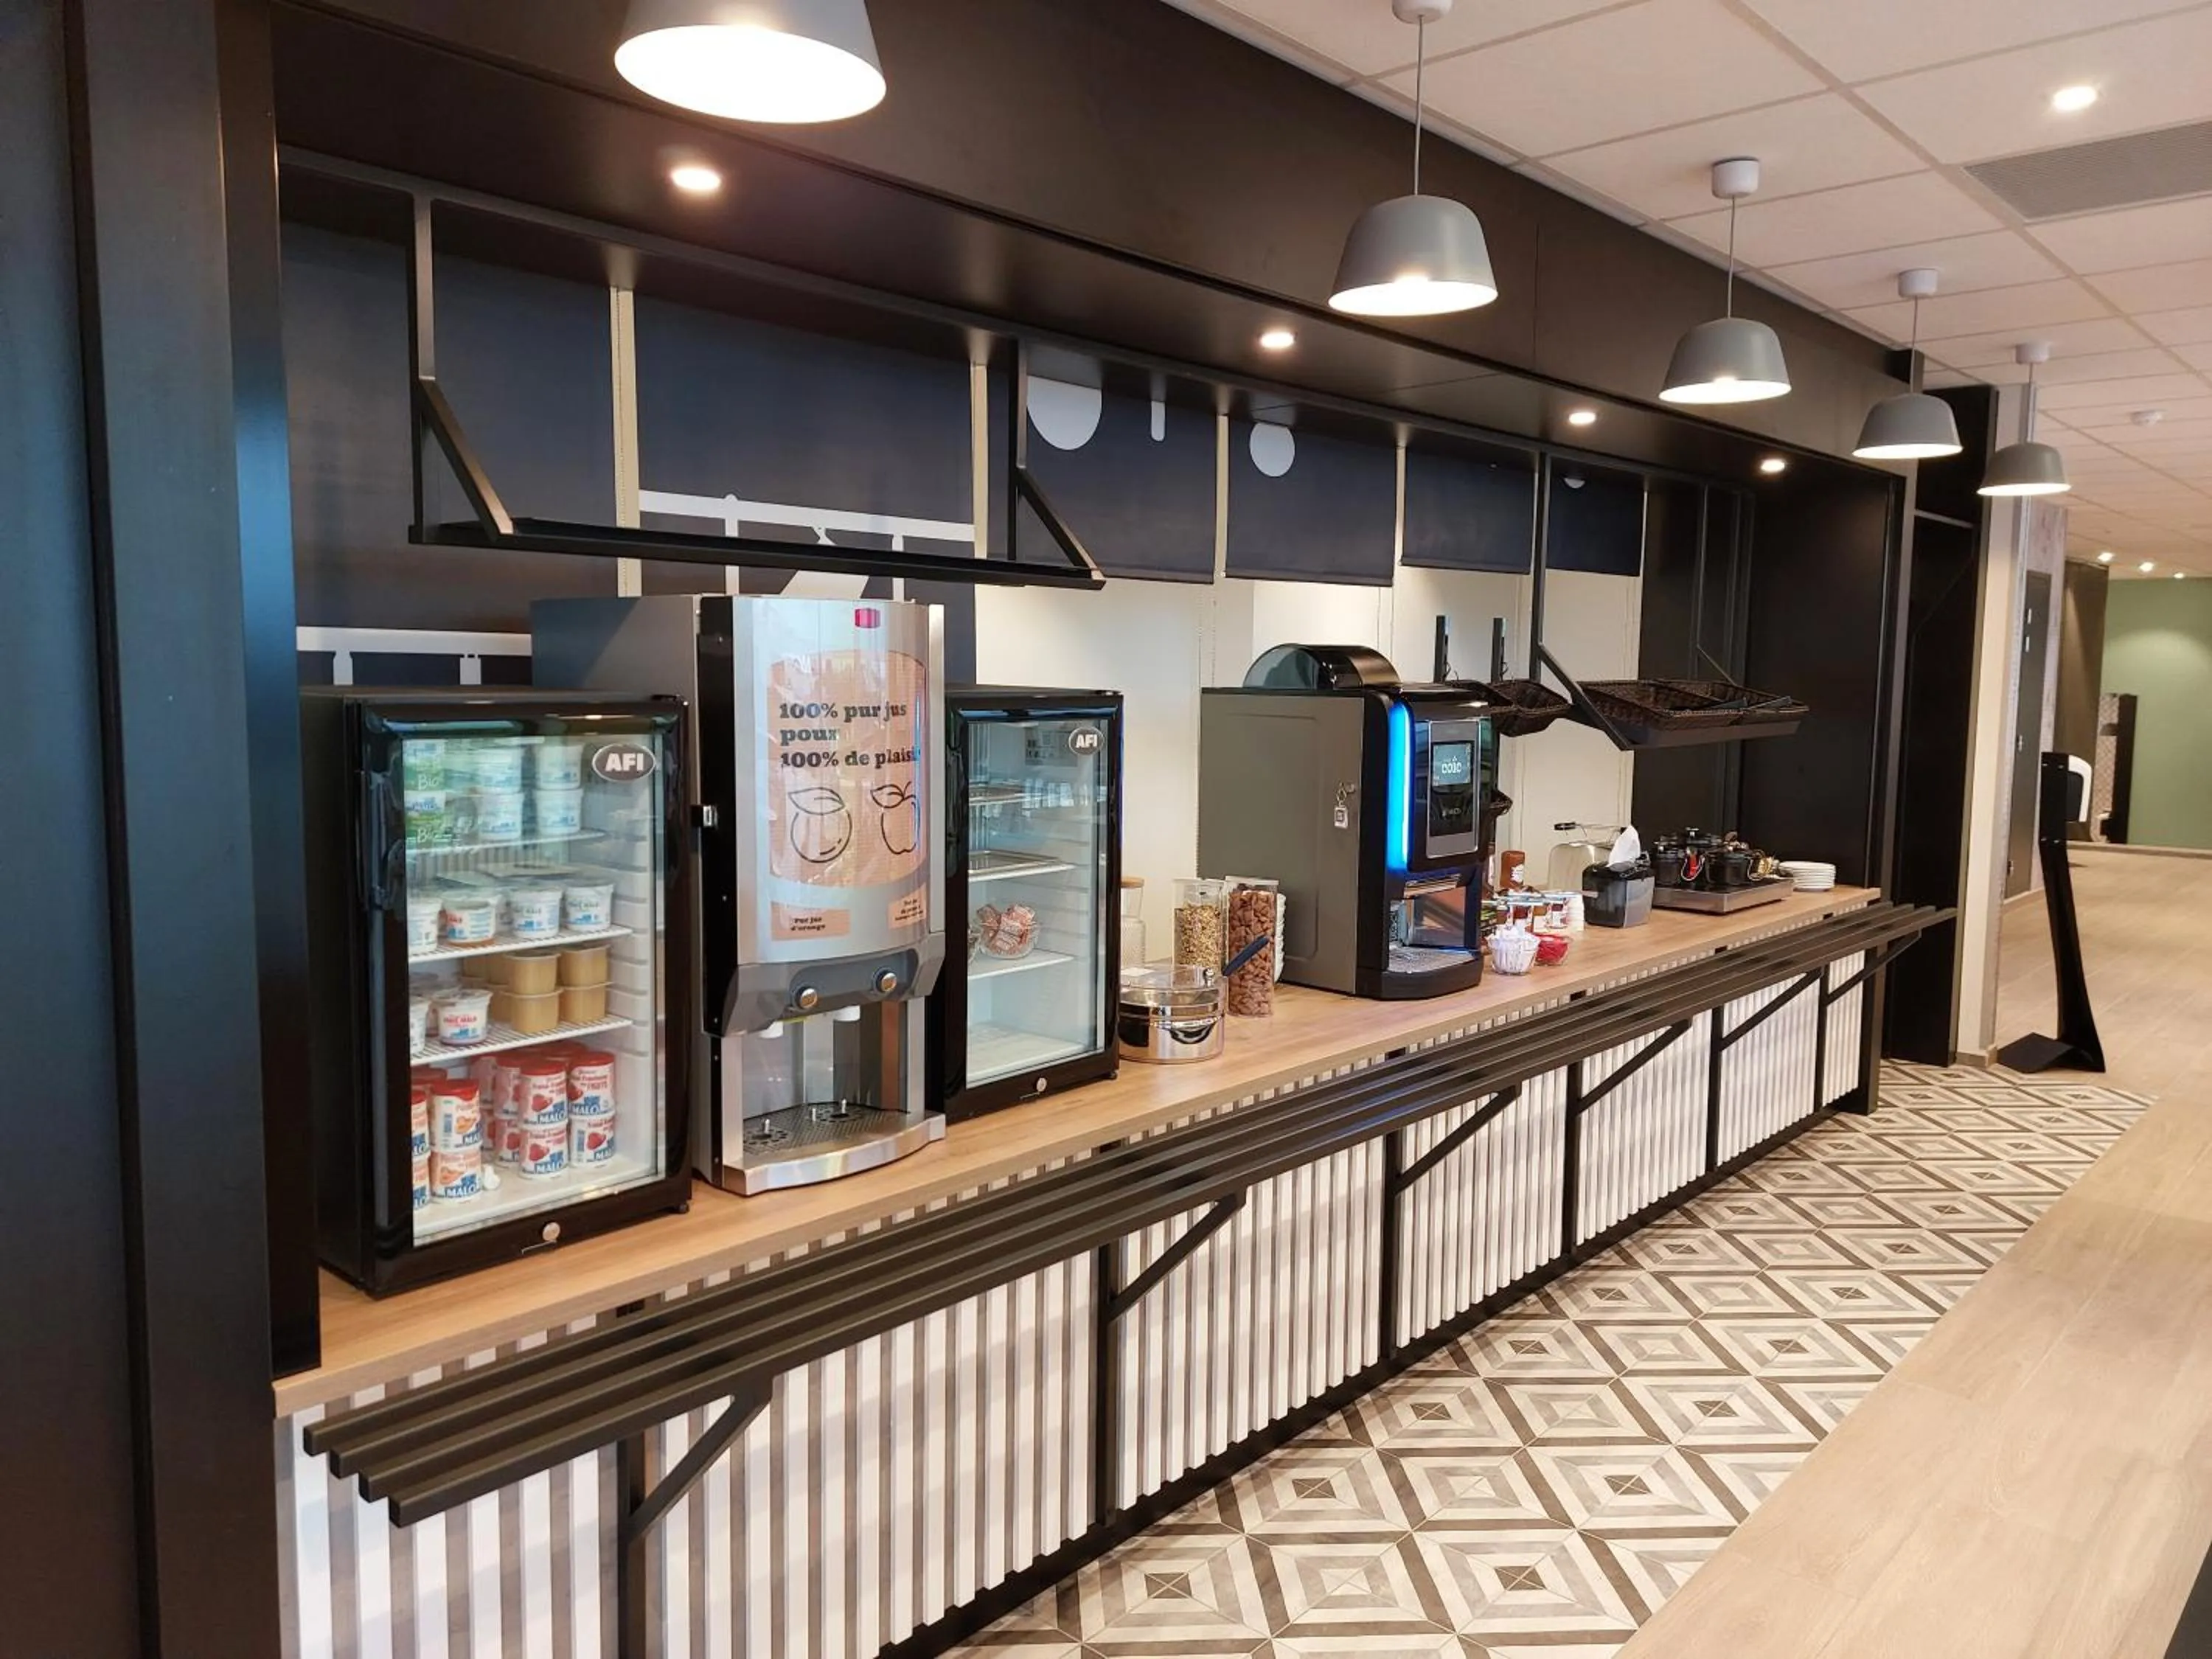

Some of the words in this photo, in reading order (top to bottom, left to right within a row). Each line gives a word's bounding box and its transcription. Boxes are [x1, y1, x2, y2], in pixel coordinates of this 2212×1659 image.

[779, 703, 838, 719] 100%
[844, 705, 880, 723] pur
[883, 701, 907, 721] jus
[780, 728, 839, 746] pour
[1076, 734, 1097, 748] AFI
[605, 753, 644, 772] AFI
[781, 751, 839, 768] 100%
[845, 751, 869, 766] de
